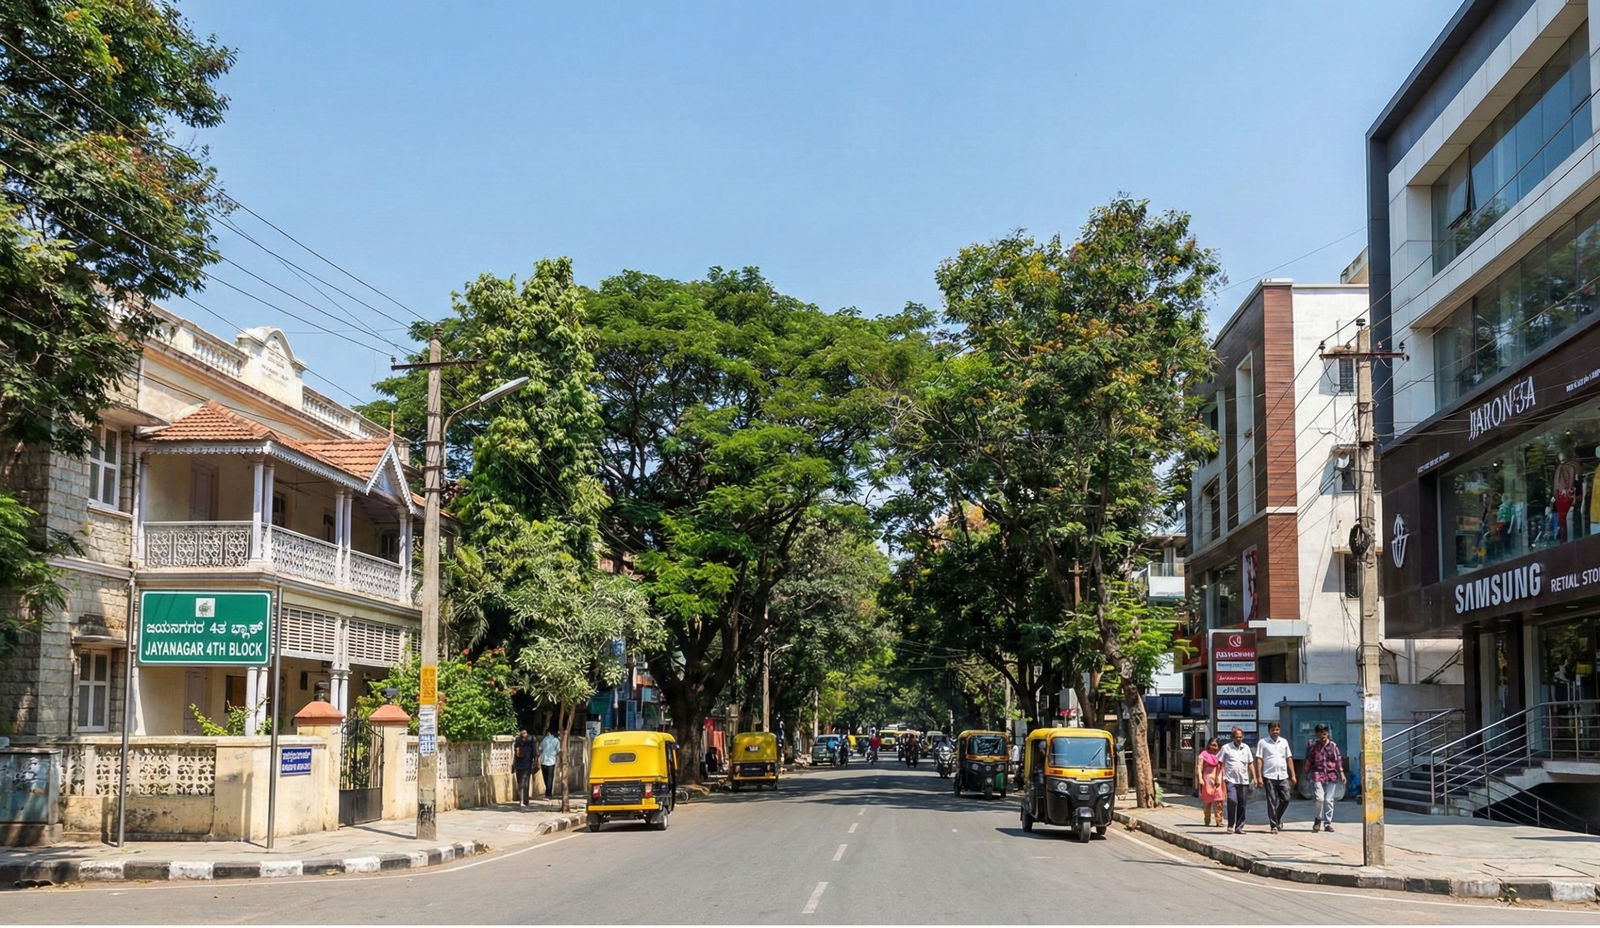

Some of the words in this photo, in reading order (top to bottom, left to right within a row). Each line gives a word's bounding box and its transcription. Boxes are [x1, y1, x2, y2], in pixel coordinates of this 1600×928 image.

[1582, 567, 1600, 585] STO
[1455, 562, 1541, 614] SAMSUNG
[145, 641, 204, 656] JAYANAGAR
[206, 642, 226, 656] 4TH
[229, 642, 263, 656] BLOCK
